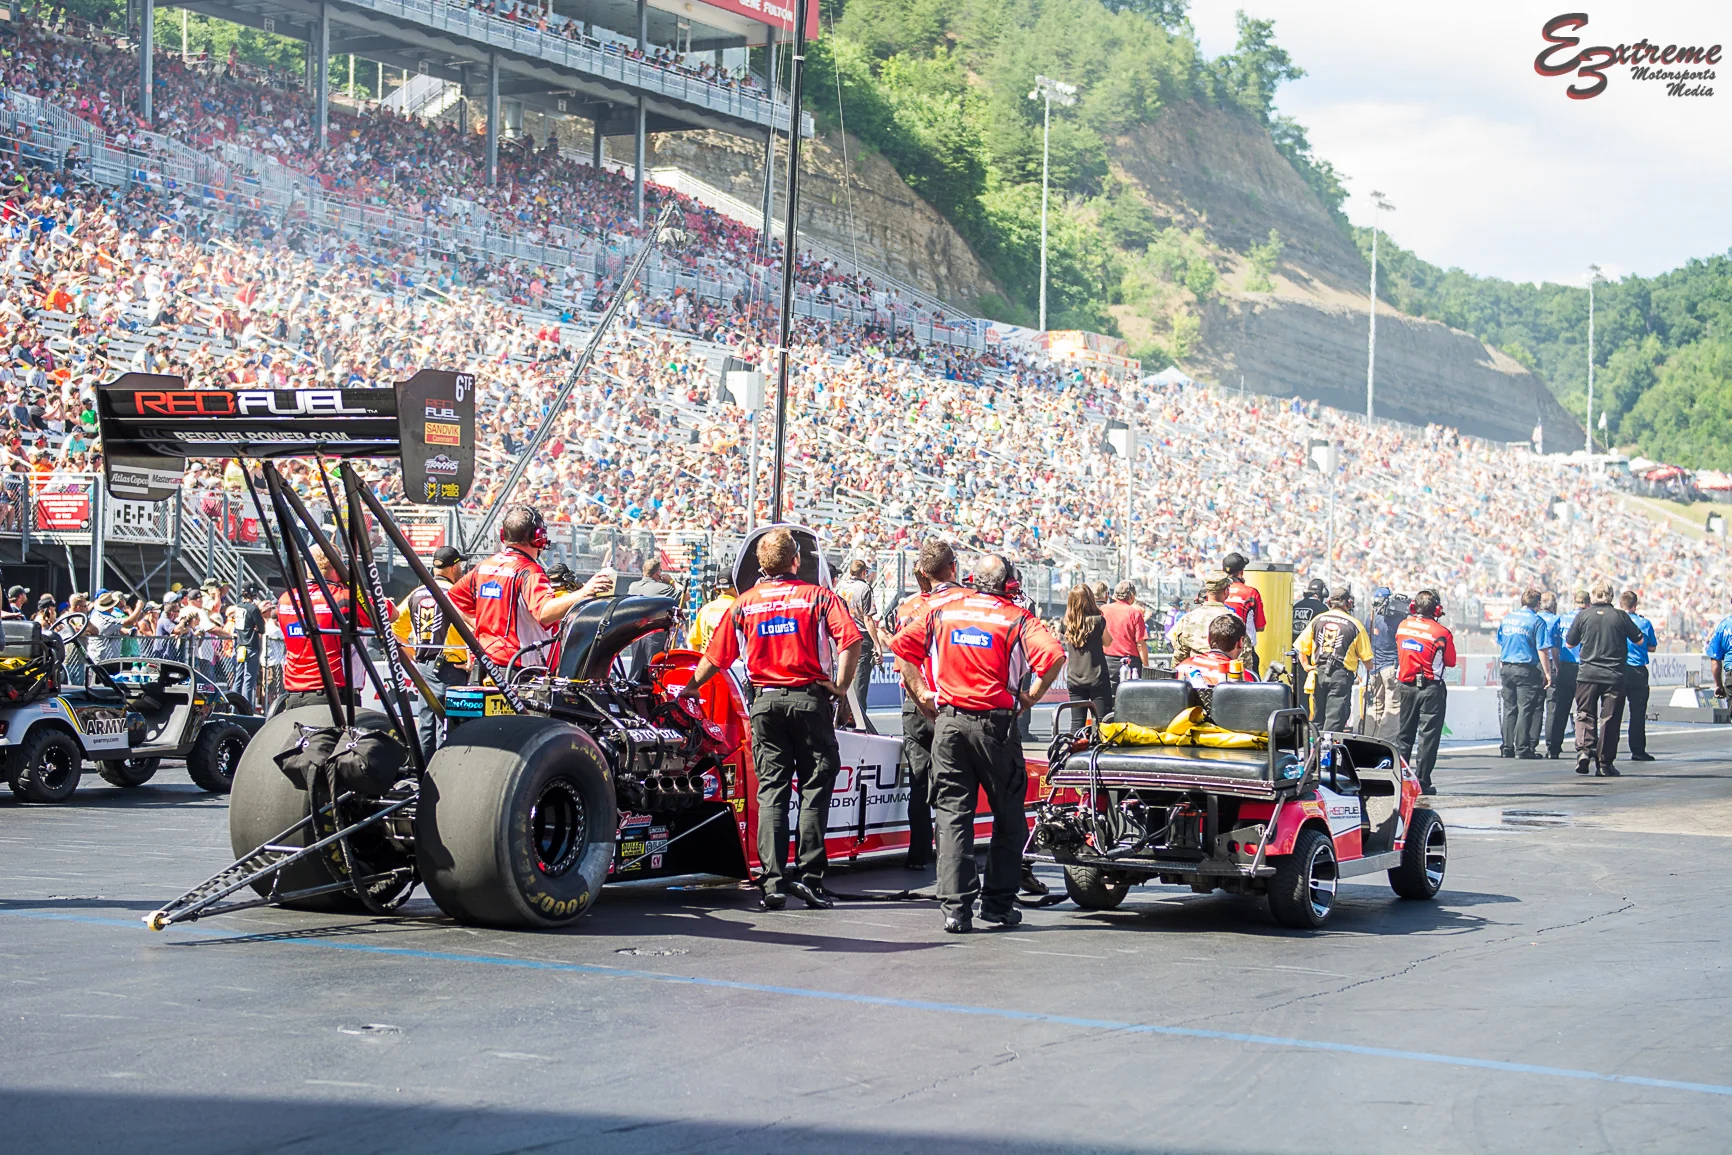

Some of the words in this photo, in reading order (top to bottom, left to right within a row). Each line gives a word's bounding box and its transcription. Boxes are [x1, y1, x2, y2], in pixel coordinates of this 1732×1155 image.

[763, 1, 793, 22] FULTON
[425, 398, 455, 409] RED
[425, 406, 461, 418] FUEL
[426, 423, 460, 435] SANDVIK
[111, 473, 130, 483] Atlas
[130, 474, 148, 486] Copco
[1294, 610, 1309, 620] FOX
[368, 560, 407, 693] TOYOTARACING.COM
[761, 621, 796, 635] LOWE'S
[953, 631, 990, 647] LOWE'S
[481, 654, 524, 712] GOODYEAR
[86, 718, 126, 735] ARMY
[92, 736, 119, 745] goarmy.com
[643, 729, 683, 740] TOOTA
[842, 797, 858, 807] BY
[866, 792, 911, 806] SCHUMAC
